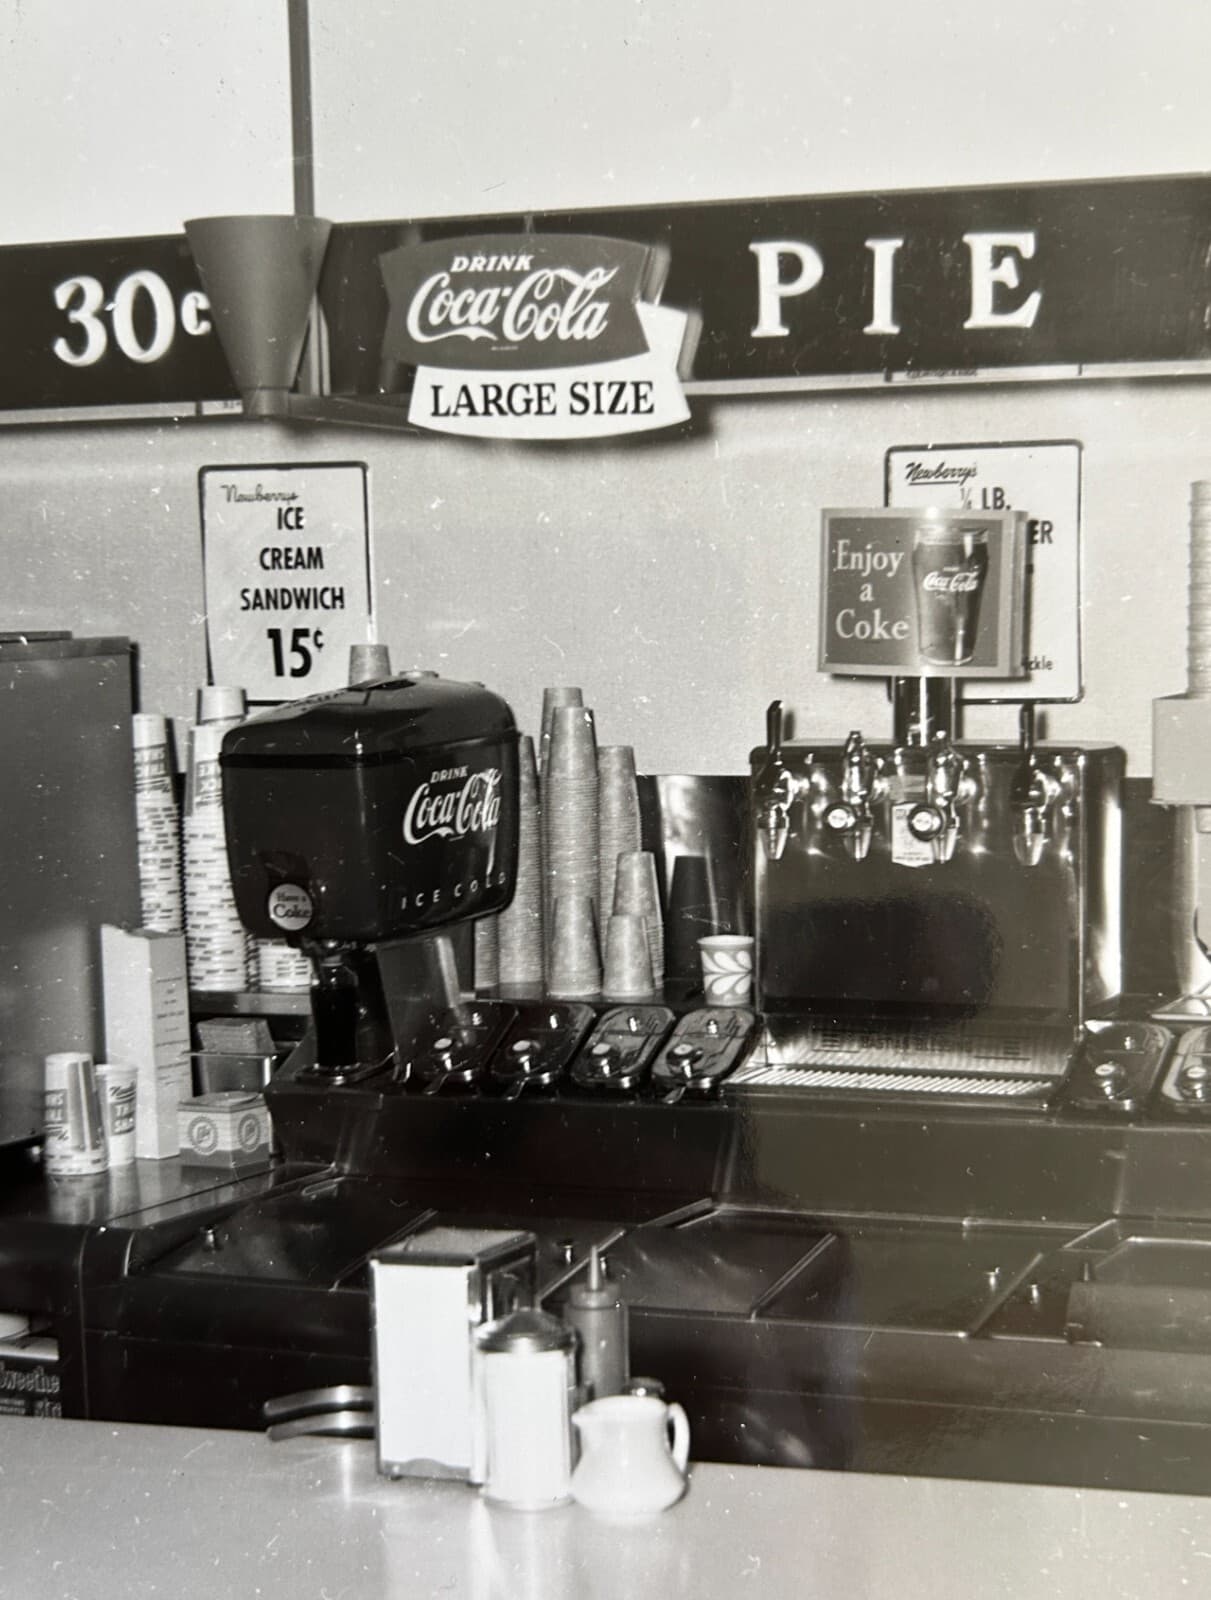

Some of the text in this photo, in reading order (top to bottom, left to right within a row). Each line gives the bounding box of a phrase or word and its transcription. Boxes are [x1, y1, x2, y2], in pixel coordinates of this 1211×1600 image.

[450, 255, 534, 273] DRINK
[406, 266, 619, 344] Coca-Cola
[430, 381, 655, 417] LARGE SIZE
[981, 486, 1012, 511] LB.
[276, 507, 304, 530] ICE
[1025, 519, 1054, 545] ER
[259, 547, 325, 570] CREAM
[836, 539, 904, 577] Enjoy
[240, 586, 345, 611] SANDWICH
[859, 583, 874, 602] a
[835, 607, 910, 641] Coke
[430, 765, 469, 784] DRINK
[402, 768, 503, 846] Coca-Cola
[400, 889, 441, 911] ICE
